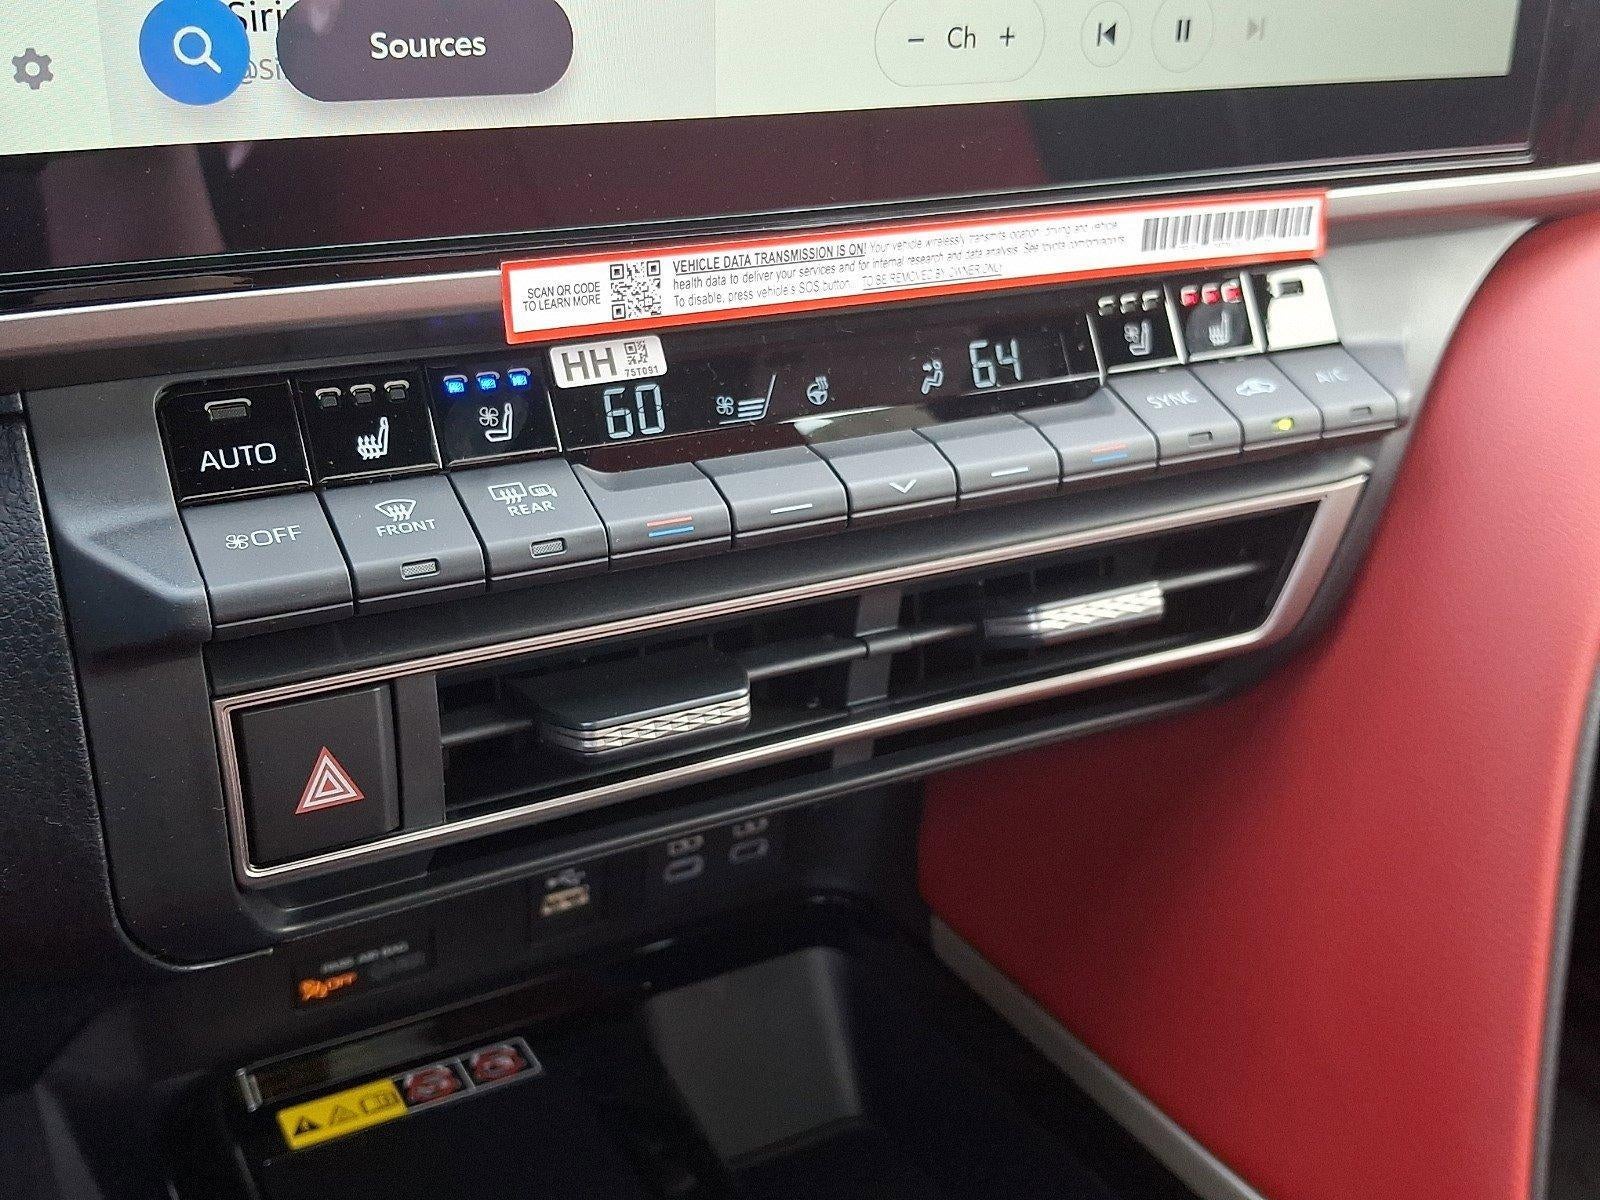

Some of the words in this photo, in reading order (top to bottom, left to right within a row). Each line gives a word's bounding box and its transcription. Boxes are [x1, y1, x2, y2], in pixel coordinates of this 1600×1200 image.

[370, 31, 487, 60] Sources
[947, 25, 976, 49] Ch
[673, 256, 720, 273] VEHICLE
[723, 254, 752, 269] DATA
[755, 246, 834, 266] TRANSMISSION
[836, 244, 845, 258] IS
[849, 242, 867, 256] ON!
[870, 241, 890, 254] Your
[673, 276, 703, 290] health
[706, 275, 727, 288] data
[730, 273, 739, 285] to
[743, 270, 774, 283] deliver
[776, 268, 796, 282] your
[799, 263, 836, 278] services
[839, 260, 855, 273] and
[858, 258, 870, 271] for
[873, 255, 904, 269] internal
[907, 252, 944, 266] research
[876, 273, 887, 286] BE
[523, 300, 536, 312] TO
[539, 296, 571, 311] LEARN
[573, 293, 601, 307] MORE
[527, 285, 554, 299] SCAN
[556, 284, 571, 296] QR
[573, 281, 601, 294] CODE
[674, 294, 685, 307] To
[688, 291, 725, 307] disable,
[728, 289, 754, 303] press
[757, 284, 795, 299] vehicle's
[799, 280, 820, 294] SOS
[561, 347, 618, 382] HH
[968, 338, 1022, 388] 64
[603, 382, 666, 440] 60
[1146, 389, 1197, 409] SYNC
[200, 442, 277, 472] AUTO
[507, 500, 555, 517] REAR
[250, 524, 302, 547] OFF
[375, 518, 436, 537] FRONT
